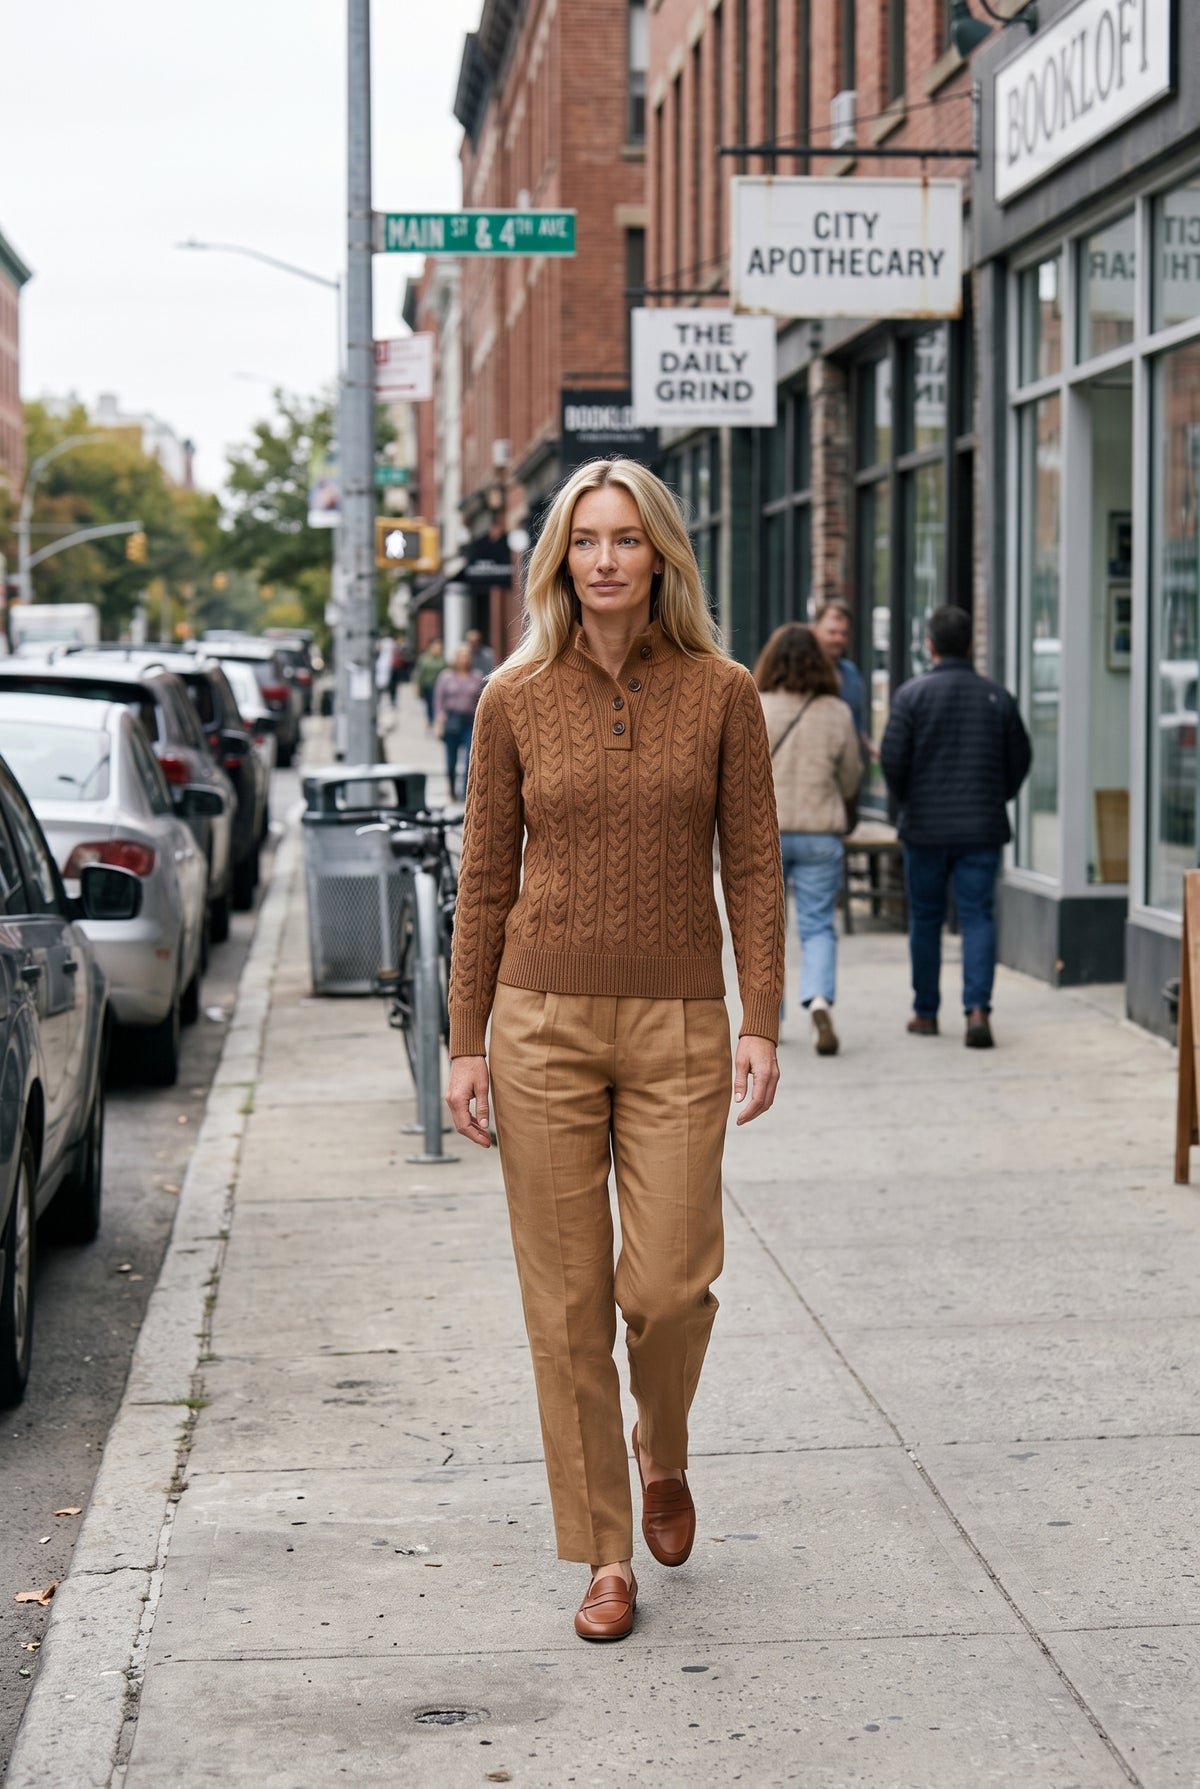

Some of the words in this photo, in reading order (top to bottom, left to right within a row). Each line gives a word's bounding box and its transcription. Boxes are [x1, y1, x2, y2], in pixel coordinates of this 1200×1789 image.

[1007, 0, 1148, 167] BOOKLOFT
[387, 216, 446, 248] MAIN
[450, 217, 469, 238] ST
[474, 216, 493, 250] &
[498, 217, 533, 250] 4TH
[537, 217, 568, 238] AVE
[813, 211, 880, 241] CITY
[747, 247, 945, 278] APOTHECARY
[675, 322, 734, 345] THE
[660, 351, 749, 374] DAILY
[655, 379, 754, 403] GRIND
